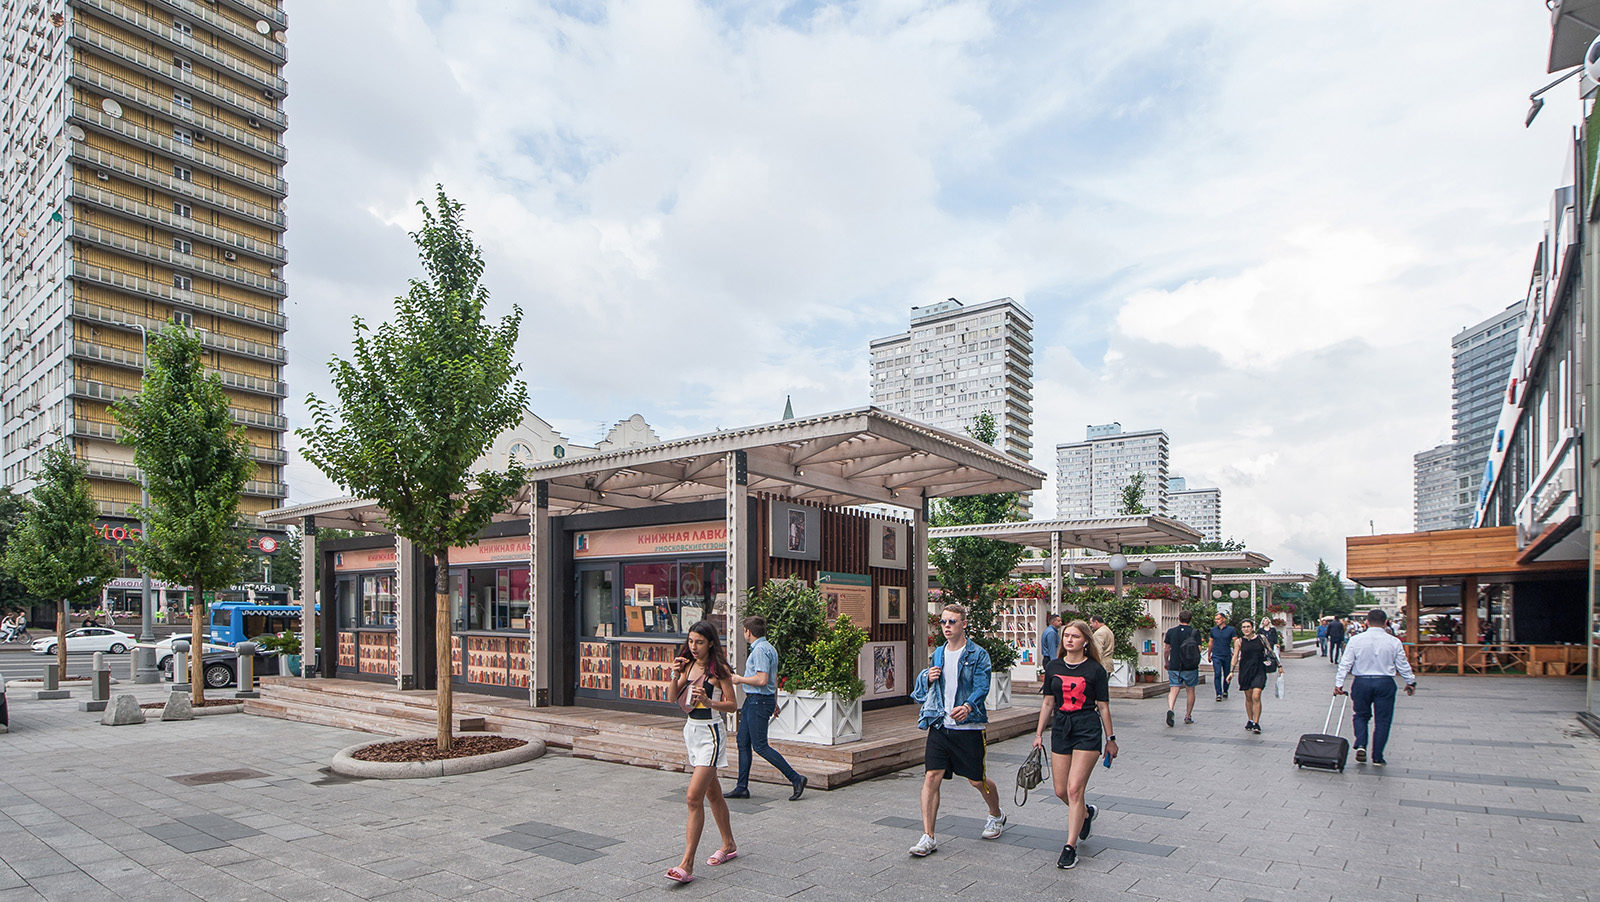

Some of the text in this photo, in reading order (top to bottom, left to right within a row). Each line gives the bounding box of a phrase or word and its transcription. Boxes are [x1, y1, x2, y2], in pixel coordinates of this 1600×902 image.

[638, 531, 689, 544] КНИЖНАЯ
[480, 543, 530, 554] КНИЖНАЯ ЛАВ
[1053, 674, 1086, 711] B
